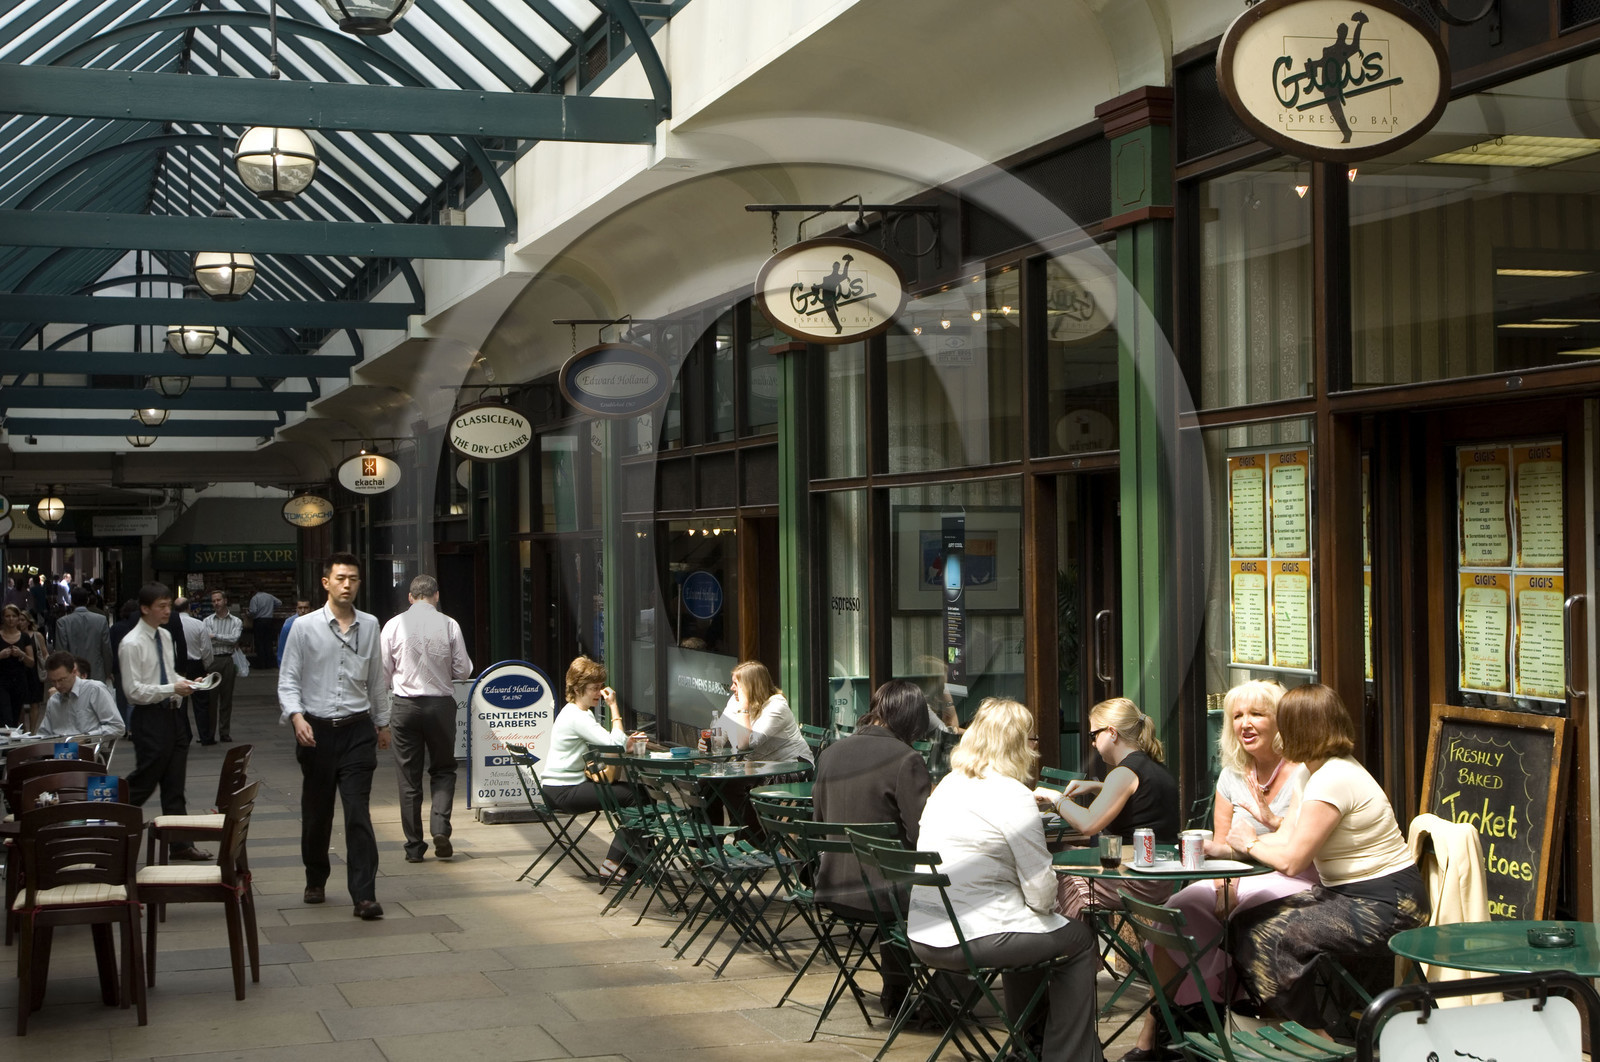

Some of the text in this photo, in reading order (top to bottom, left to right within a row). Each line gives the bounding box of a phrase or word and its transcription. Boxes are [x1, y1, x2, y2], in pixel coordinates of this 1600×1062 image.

[1278, 113, 1399, 125] ESPRESO BAR
[582, 374, 650, 385] Edward Holland
[456, 414, 524, 429] CLASSICLEAN
[453, 433, 529, 454] THE DRY-CLEANER
[1280, 453, 1297, 463] GIGI'S
[1474, 451, 1496, 462] GIGI'S
[1528, 447, 1551, 459] GIGI'S
[355, 477, 385, 486] ekachai
[194, 549, 297, 563] SWEET EXPR
[1241, 562, 1257, 572] GIGI'S
[1282, 562, 1299, 572] GIGI'S
[1474, 575, 1497, 586] GIGI'S
[1529, 577, 1553, 588] GIGI'S
[831, 596, 860, 615] espresso
[484, 684, 540, 694] Edward Holland
[478, 711, 548, 720] GENTLEMENS
[489, 720, 537, 728] BARBERS
[1450, 739, 1504, 767] FRESHLY
[492, 757, 521, 765] OPE
[1457, 768, 1503, 789] BAKED
[478, 789, 496, 798] 020
[499, 788, 522, 797] 7623
